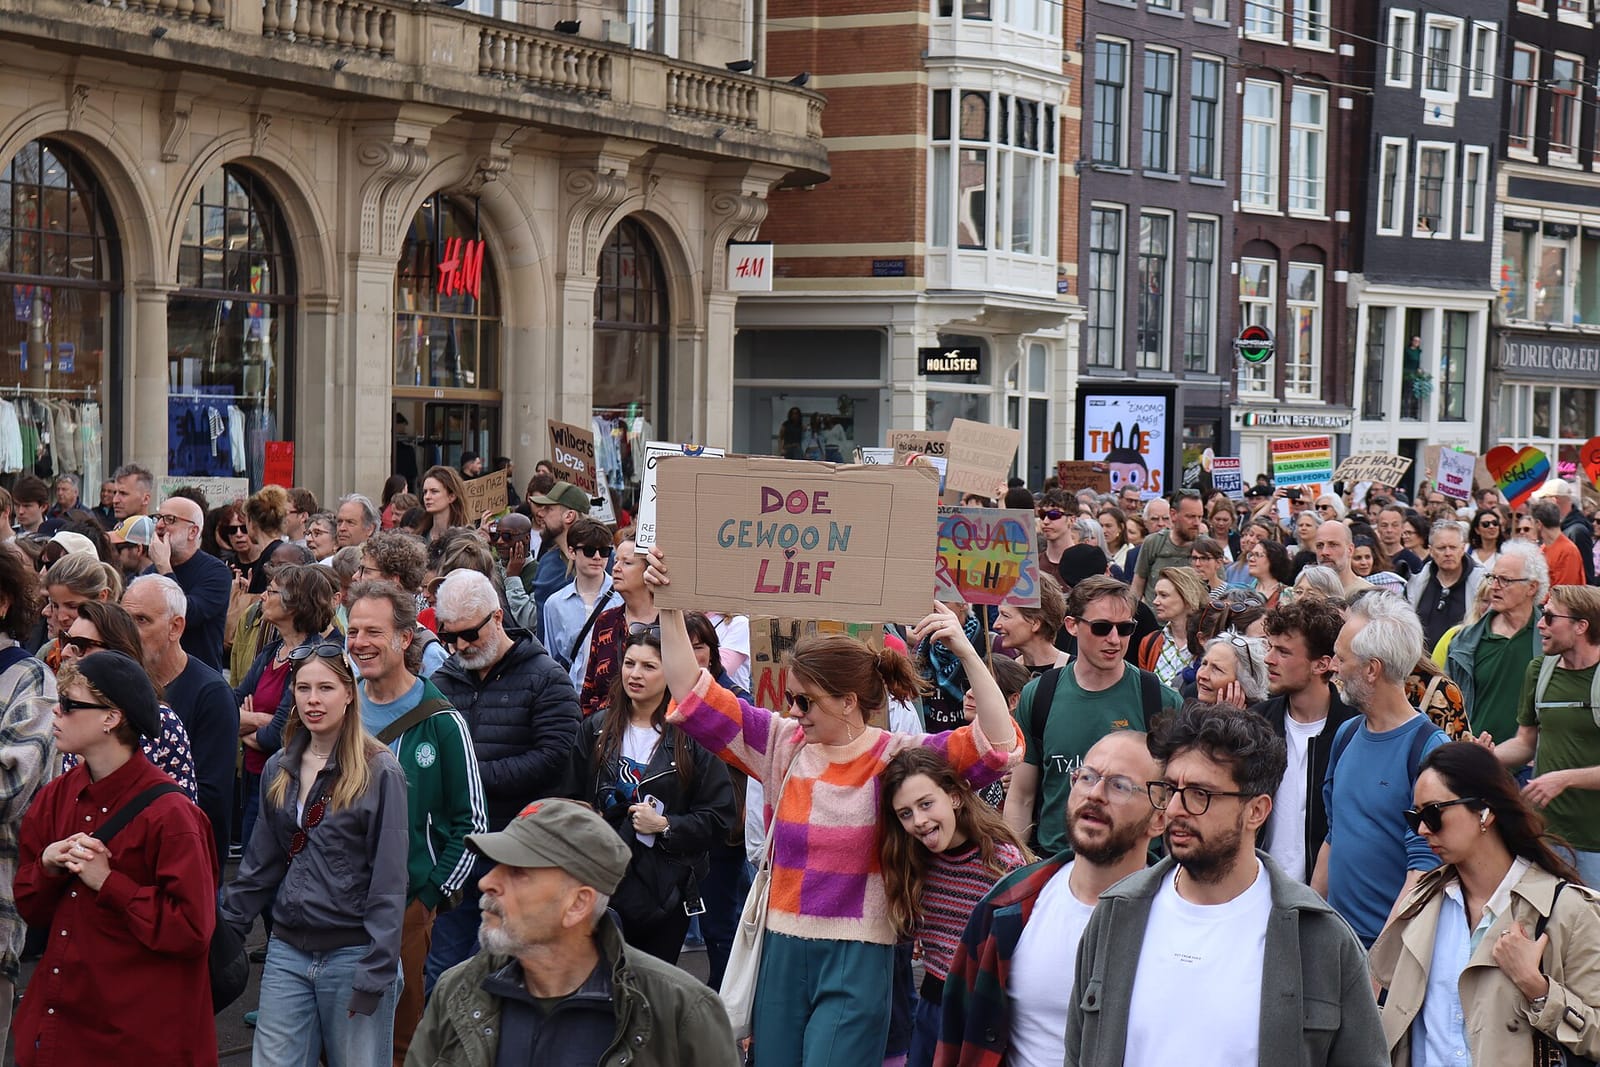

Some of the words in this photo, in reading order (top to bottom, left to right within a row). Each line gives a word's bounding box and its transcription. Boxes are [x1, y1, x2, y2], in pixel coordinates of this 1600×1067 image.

[437, 236, 484, 300] H&M
[735, 257, 764, 278] H&M
[1519, 344, 1551, 368] DRIE
[927, 358, 977, 371] HOLLISTER
[1257, 414, 1291, 425] ITALIAN
[1292, 416, 1348, 428] RESTAURANT
[924, 441, 945, 454] ASS
[1273, 442, 1300, 450] BEING
[1302, 439, 1329, 447] WOKE
[1214, 460, 1239, 468] MASSA
[1283, 463, 1304, 471] DAMN
[1370, 456, 1409, 469] HAAT
[1277, 475, 1301, 484] OTHER
[1303, 472, 1330, 481] PEOPLE
[1361, 468, 1402, 486] MACHT
[1217, 481, 1240, 491] HAAT
[760, 486, 831, 515] DOE
[716, 518, 852, 552] GEWOON
[754, 558, 836, 596] LIEF
